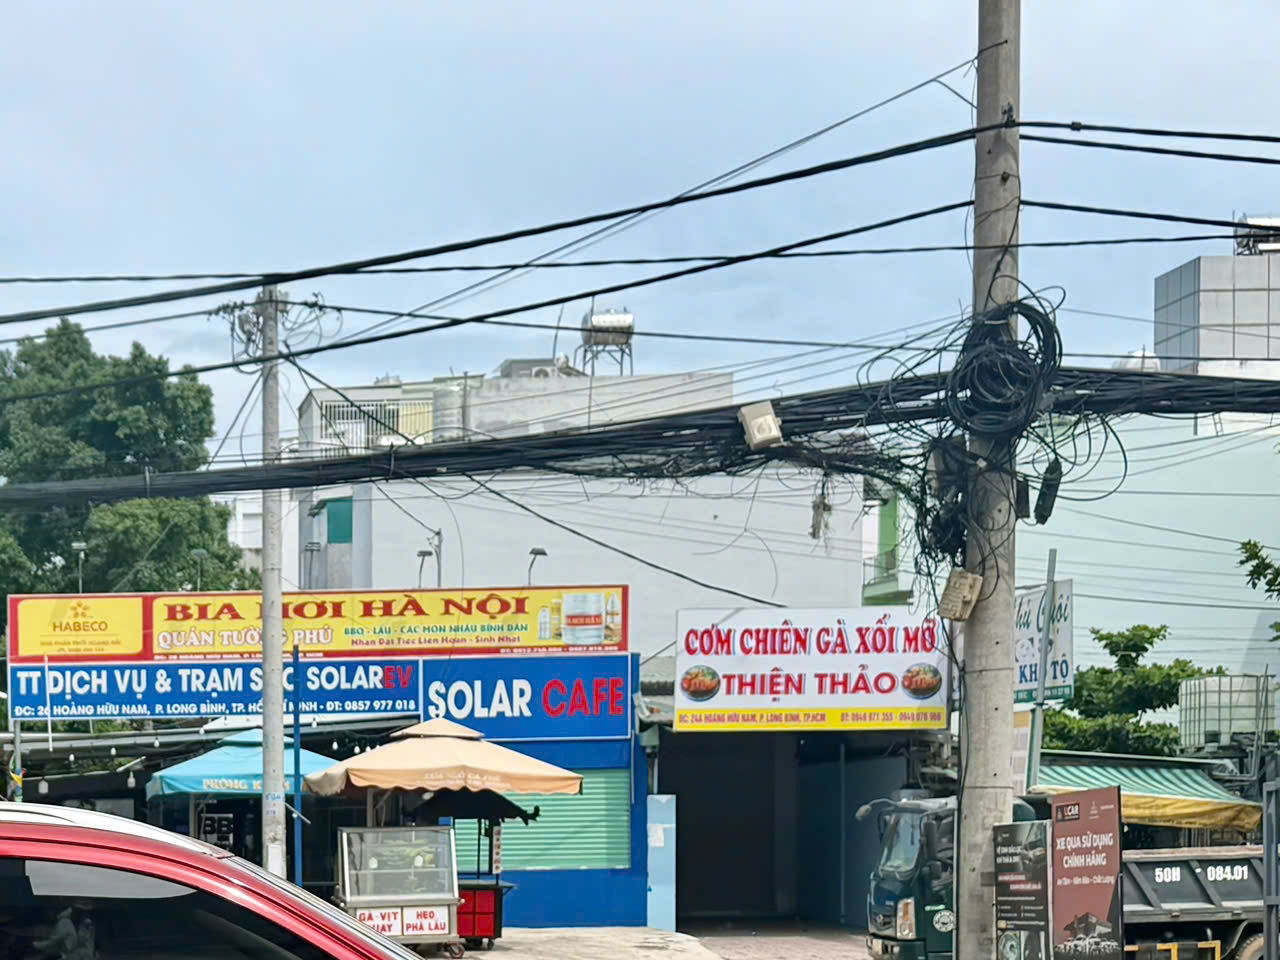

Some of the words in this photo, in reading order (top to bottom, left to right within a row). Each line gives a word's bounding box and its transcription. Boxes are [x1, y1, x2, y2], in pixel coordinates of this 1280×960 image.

[164, 602, 245, 621] BIA
[360, 594, 429, 618] HÀ
[440, 593, 529, 619] NỘI
[52, 620, 109, 632] HABECO
[157, 626, 216, 649] QUÁN
[219, 626, 289, 647] TƯỜ
[293, 624, 333, 645] PHÚ
[684, 623, 733, 656] CƠM
[739, 619, 811, 656] CHIÊN
[816, 618, 850, 655] GÀ
[855, 613, 897, 654] XỐI
[902, 617, 937, 653] MỠ
[1018, 662, 1039, 684] KH
[1050, 652, 1070, 684] TỘ
[16, 671, 42, 695] TT
[48, 669, 108, 700] DỊCH
[114, 669, 148, 699] VỤ
[155, 669, 172, 693] &
[178, 667, 244, 698] TRẠM
[250, 666, 294, 691] SC
[722, 666, 805, 702] THIỆN
[814, 664, 897, 694] THẢO
[53, 702, 94, 716] HOÀNG
[97, 702, 120, 715] HỮU
[170, 703, 197, 714] LONG
[288, 701, 318, 712] MNH
[344, 701, 371, 711] 0857
[373, 700, 394, 710] 977
[395, 700, 416, 710] 018
[428, 679, 532, 720] SOLAR
[542, 677, 624, 718] CAFE
[1056, 837, 1066, 850] XE
[1066, 836, 1081, 851] QUA
[1092, 832, 1114, 850] DỤNG
[1063, 851, 1084, 869] CHÍNH
[1154, 866, 1181, 883] 50H
[1207, 865, 1249, 881] 084.01
[416, 910, 435, 920] HEO
[372, 923, 393, 934] UAY
